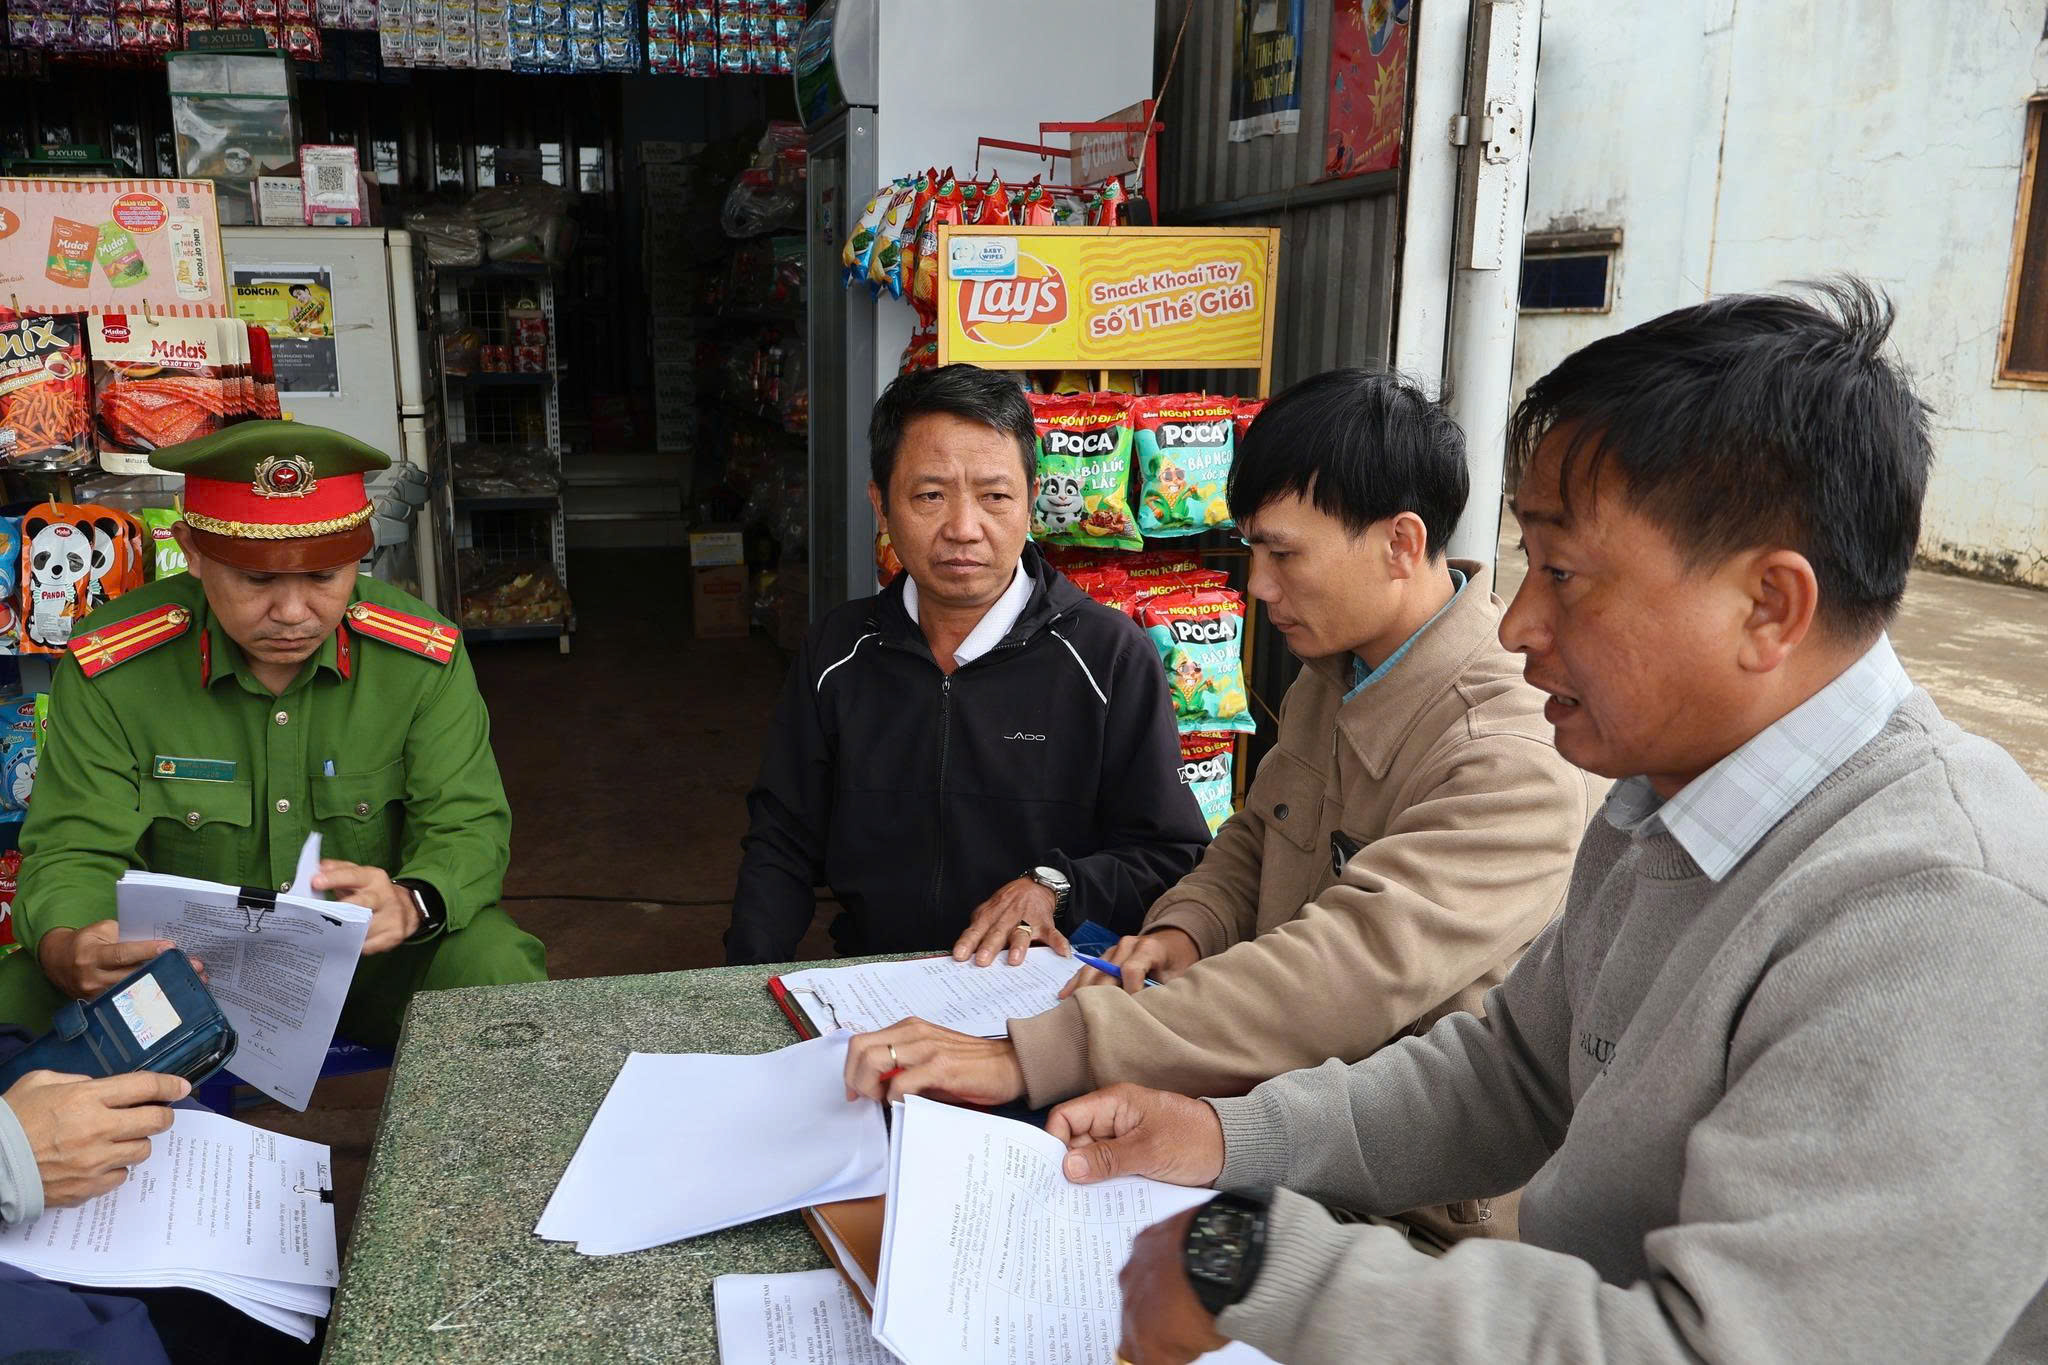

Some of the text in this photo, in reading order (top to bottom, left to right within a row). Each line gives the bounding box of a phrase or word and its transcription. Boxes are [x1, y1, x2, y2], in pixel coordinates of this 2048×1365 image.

[212, 34, 254, 43] XYLITOL
[57, 239, 88, 250] Midas
[98, 234, 128, 256] Midas
[196, 248, 202, 256] OF
[196, 258, 204, 277] FOOD
[1094, 261, 1240, 302] Snack Khoai Tây
[237, 288, 280, 296] BONCHA
[968, 276, 1061, 322] Lay's
[295, 302, 316, 322] BONCHA
[1093, 284, 1254, 336] số 1 Thế Giới
[104, 328, 128, 336] Midas
[150, 340, 207, 360] Midas
[1050, 416, 1084, 426] NGON
[1085, 415, 1096, 424] 10
[1097, 411, 1128, 423] ĐIỂM
[1160, 409, 1190, 418] NGON
[1191, 409, 1204, 417] 10
[1204, 406, 1232, 416] ĐIỂM
[1050, 432, 1114, 453] POCA
[1163, 424, 1226, 445] POCA
[1081, 458, 1124, 477] BÒ LÚC
[1188, 452, 1211, 470] BẮP
[1092, 472, 1117, 490] LẮC
[1201, 470, 1218, 482] XÓC
[1130, 568, 1159, 577] NGON
[42, 590, 66, 600] PANDA
[1150, 585, 1178, 596] NGON
[1168, 606, 1198, 616] NGON
[1198, 604, 1210, 614] 10
[1210, 600, 1239, 612] ĐIỂM
[1177, 620, 1236, 642] POCA
[1202, 646, 1224, 665] BẮP
[1192, 746, 1203, 754] 10
[1204, 740, 1231, 752] ĐIỂM
